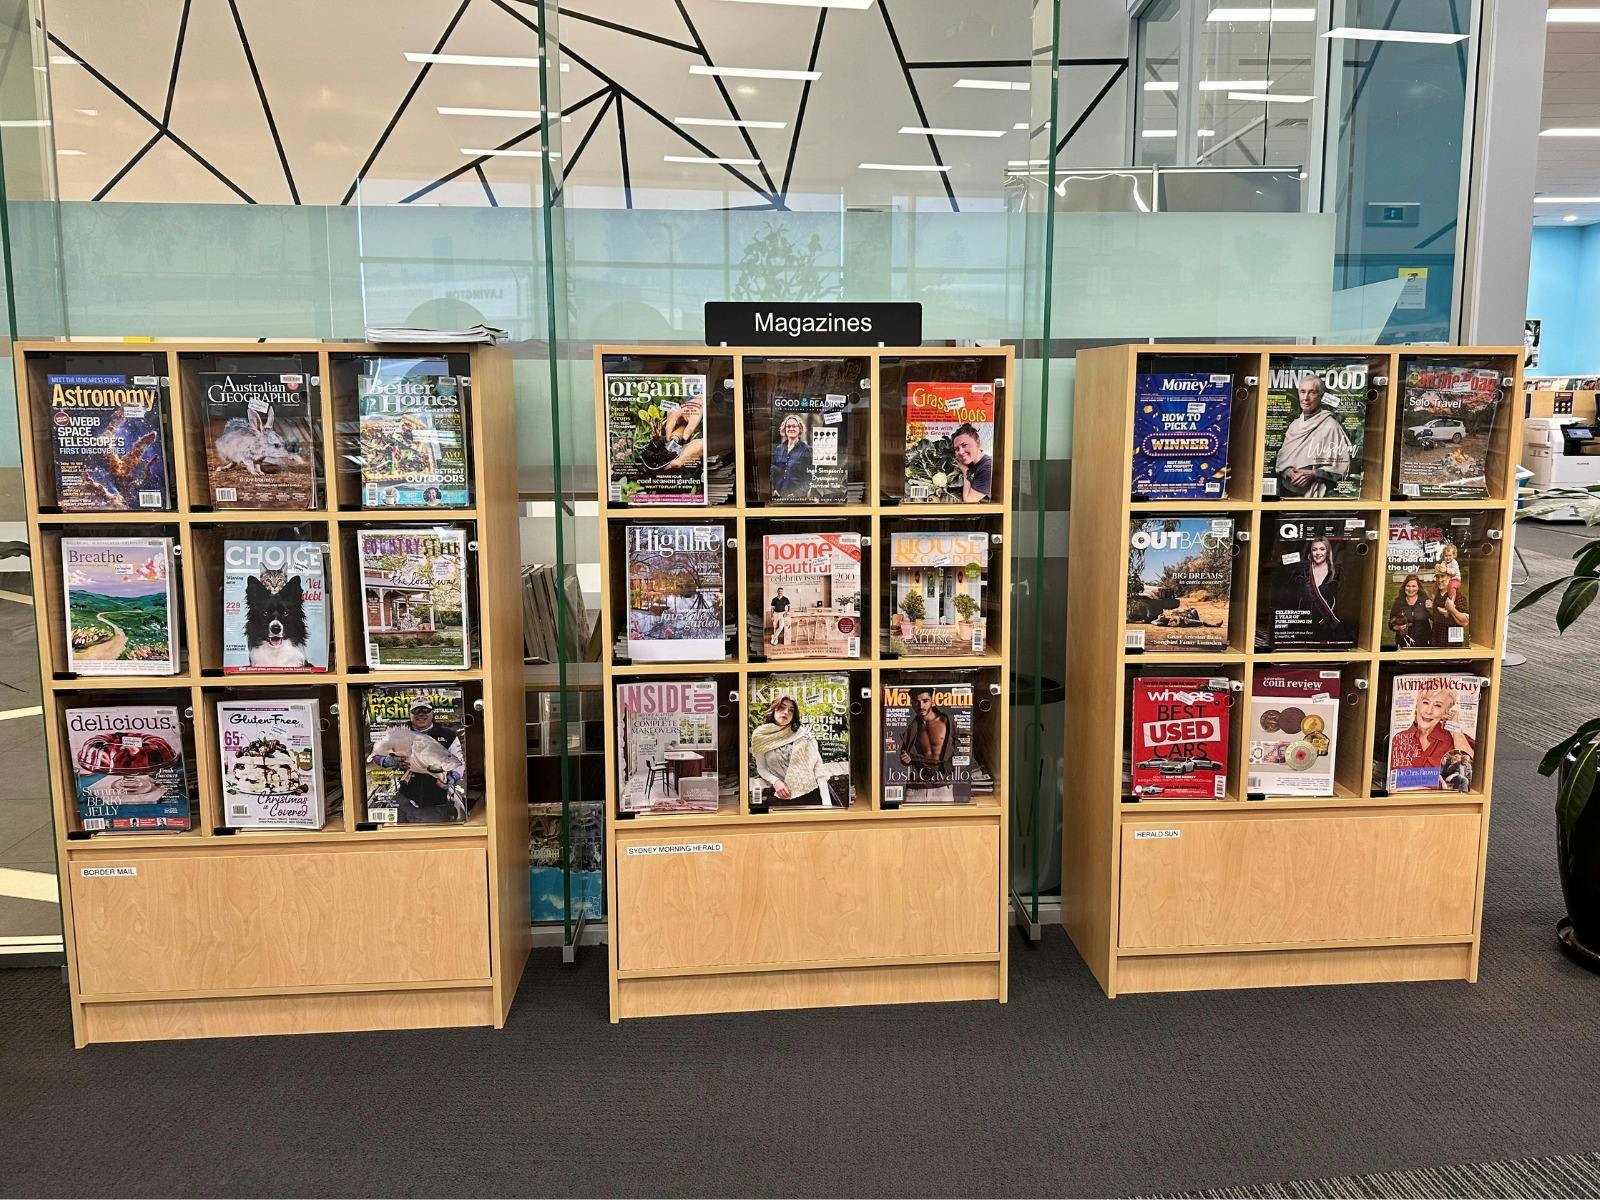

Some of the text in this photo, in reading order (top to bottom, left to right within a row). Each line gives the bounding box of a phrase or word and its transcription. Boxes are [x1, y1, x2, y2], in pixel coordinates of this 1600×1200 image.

[755, 313, 872, 337] Magazines
[223, 376, 286, 393] Australian
[364, 378, 435, 395] Better
[1162, 379, 1208, 395] Money
[52, 383, 155, 412] Astronomy
[207, 385, 300, 403] GEOGRAPHIC
[610, 380, 702, 403] organic
[379, 394, 458, 413] Homes
[774, 399, 845, 409] GOOD READING
[1409, 396, 1462, 409] Solo Travel
[70, 416, 100, 427] WEBB
[1161, 413, 1201, 422] HOW TO
[57, 426, 92, 437] SPACE
[1164, 422, 1197, 430] PICK A
[58, 437, 125, 447] TELESCOPE'S
[1151, 438, 1209, 450] WINNER
[1306, 435, 1359, 458] Wisdom
[60, 447, 126, 455] FIRST DISCOVERIES
[406, 475, 465, 483] OUTDOORS
[676, 478, 701, 486] garden
[1280, 524, 1298, 538] Q
[1388, 528, 1444, 541] FARMS
[362, 538, 420, 555] COUNTRY
[895, 534, 980, 554] HOUSE
[1131, 531, 1230, 549] OUTBACK
[764, 536, 833, 560] home
[68, 550, 124, 563] Breathe
[225, 546, 320, 566] CHOICE
[921, 555, 982, 564] GDEN
[1402, 565, 1421, 573] ugly
[834, 573, 855, 581] 200
[300, 591, 322, 601] debt
[683, 616, 721, 629] garden
[1263, 679, 1323, 688] coin review
[1396, 678, 1479, 694] Women's Weekly
[367, 692, 455, 707] Freshter
[619, 684, 714, 713] INSIDE OU
[751, 677, 848, 715] Knitting
[1148, 689, 1215, 702] whels
[370, 702, 412, 723] Fishi
[1157, 704, 1207, 720] BEST
[71, 714, 176, 732] delicious.
[633, 720, 677, 728] COMPLETE
[801, 716, 843, 724] BRITISH
[631, 727, 681, 735] MAKEOVERS
[801, 724, 836, 732] WOOL
[1149, 720, 1215, 744] USED
[802, 732, 849, 741] SPECIAL
[1153, 743, 1208, 759] CARS
[887, 767, 970, 781] Josh Cavallo
[87, 796, 122, 807] BERRY
[257, 791, 308, 804] Christmas
[85, 805, 119, 817] JELLY
[269, 804, 308, 817] Covered
